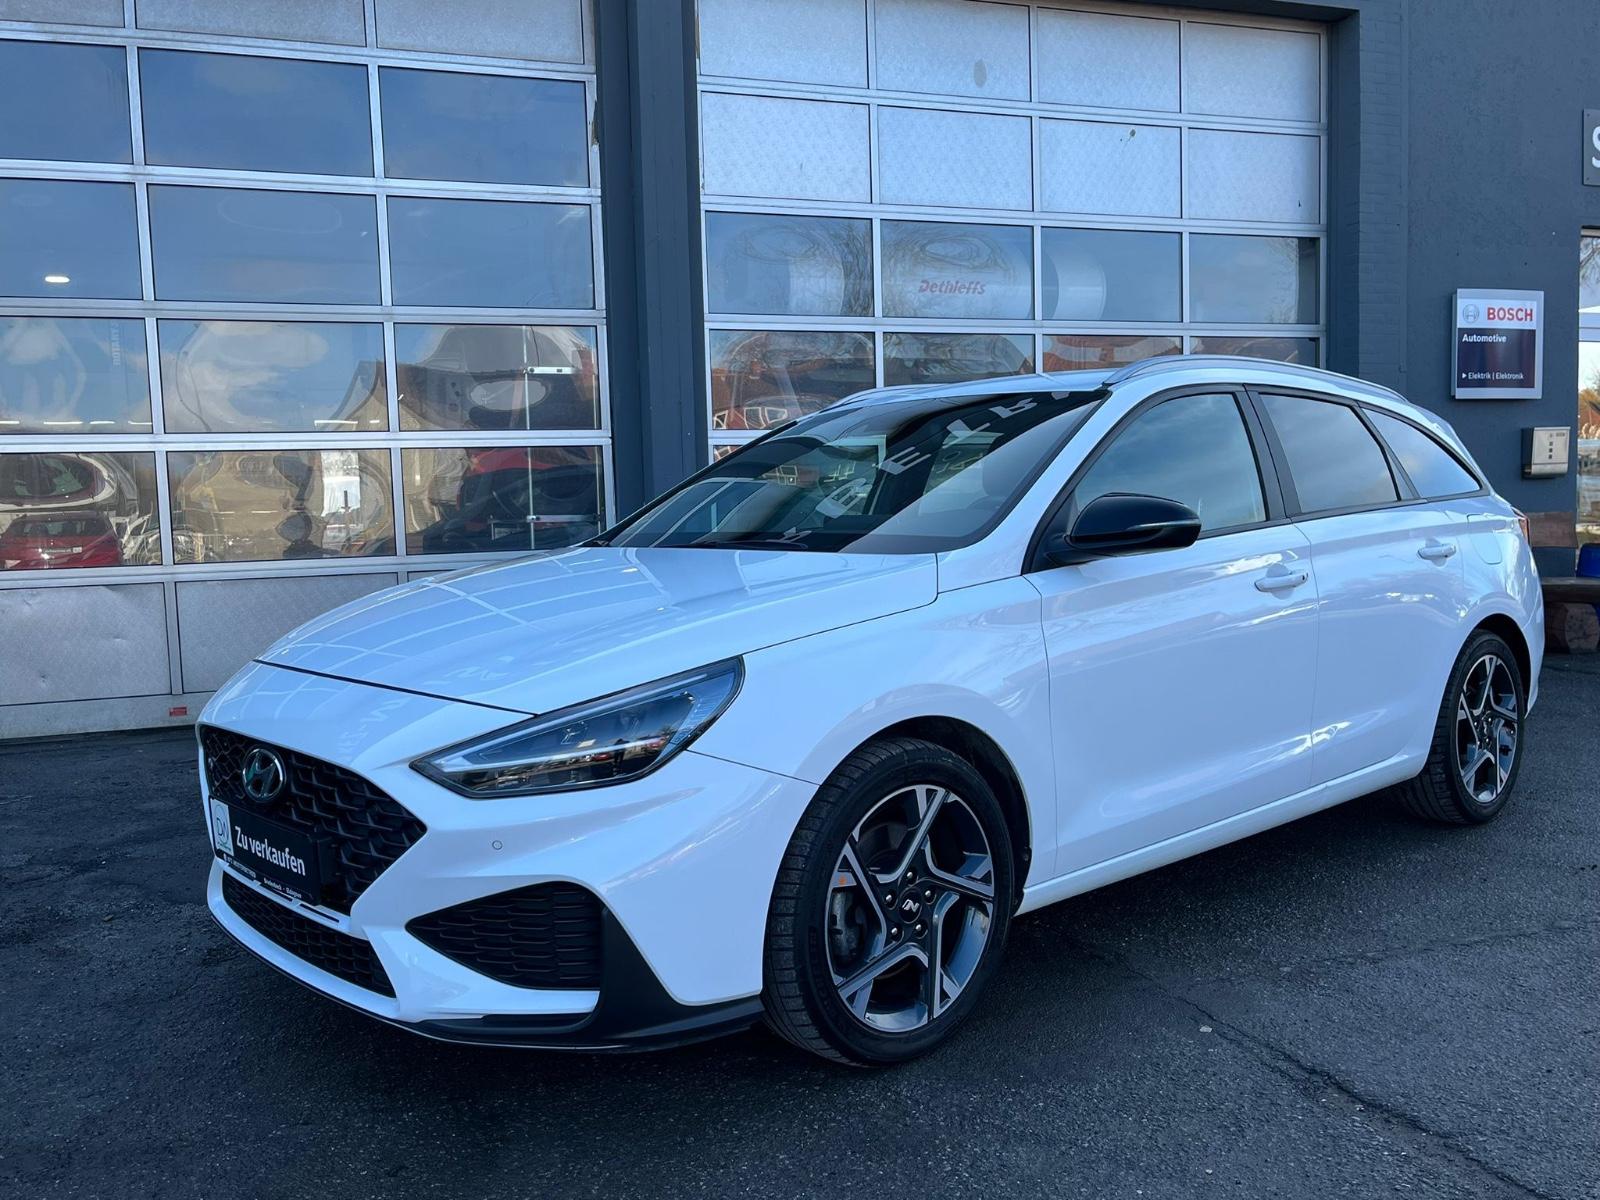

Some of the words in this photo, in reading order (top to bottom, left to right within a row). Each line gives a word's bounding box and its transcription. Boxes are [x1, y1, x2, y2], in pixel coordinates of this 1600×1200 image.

[1487, 307, 1533, 322] BOSCH
[1462, 334, 1507, 342] Automotive
[1468, 372, 1491, 380] Elektrik
[1495, 372, 1524, 380] Elektronik
[235, 825, 248, 850] Zu
[248, 838, 306, 877] verkaufen
